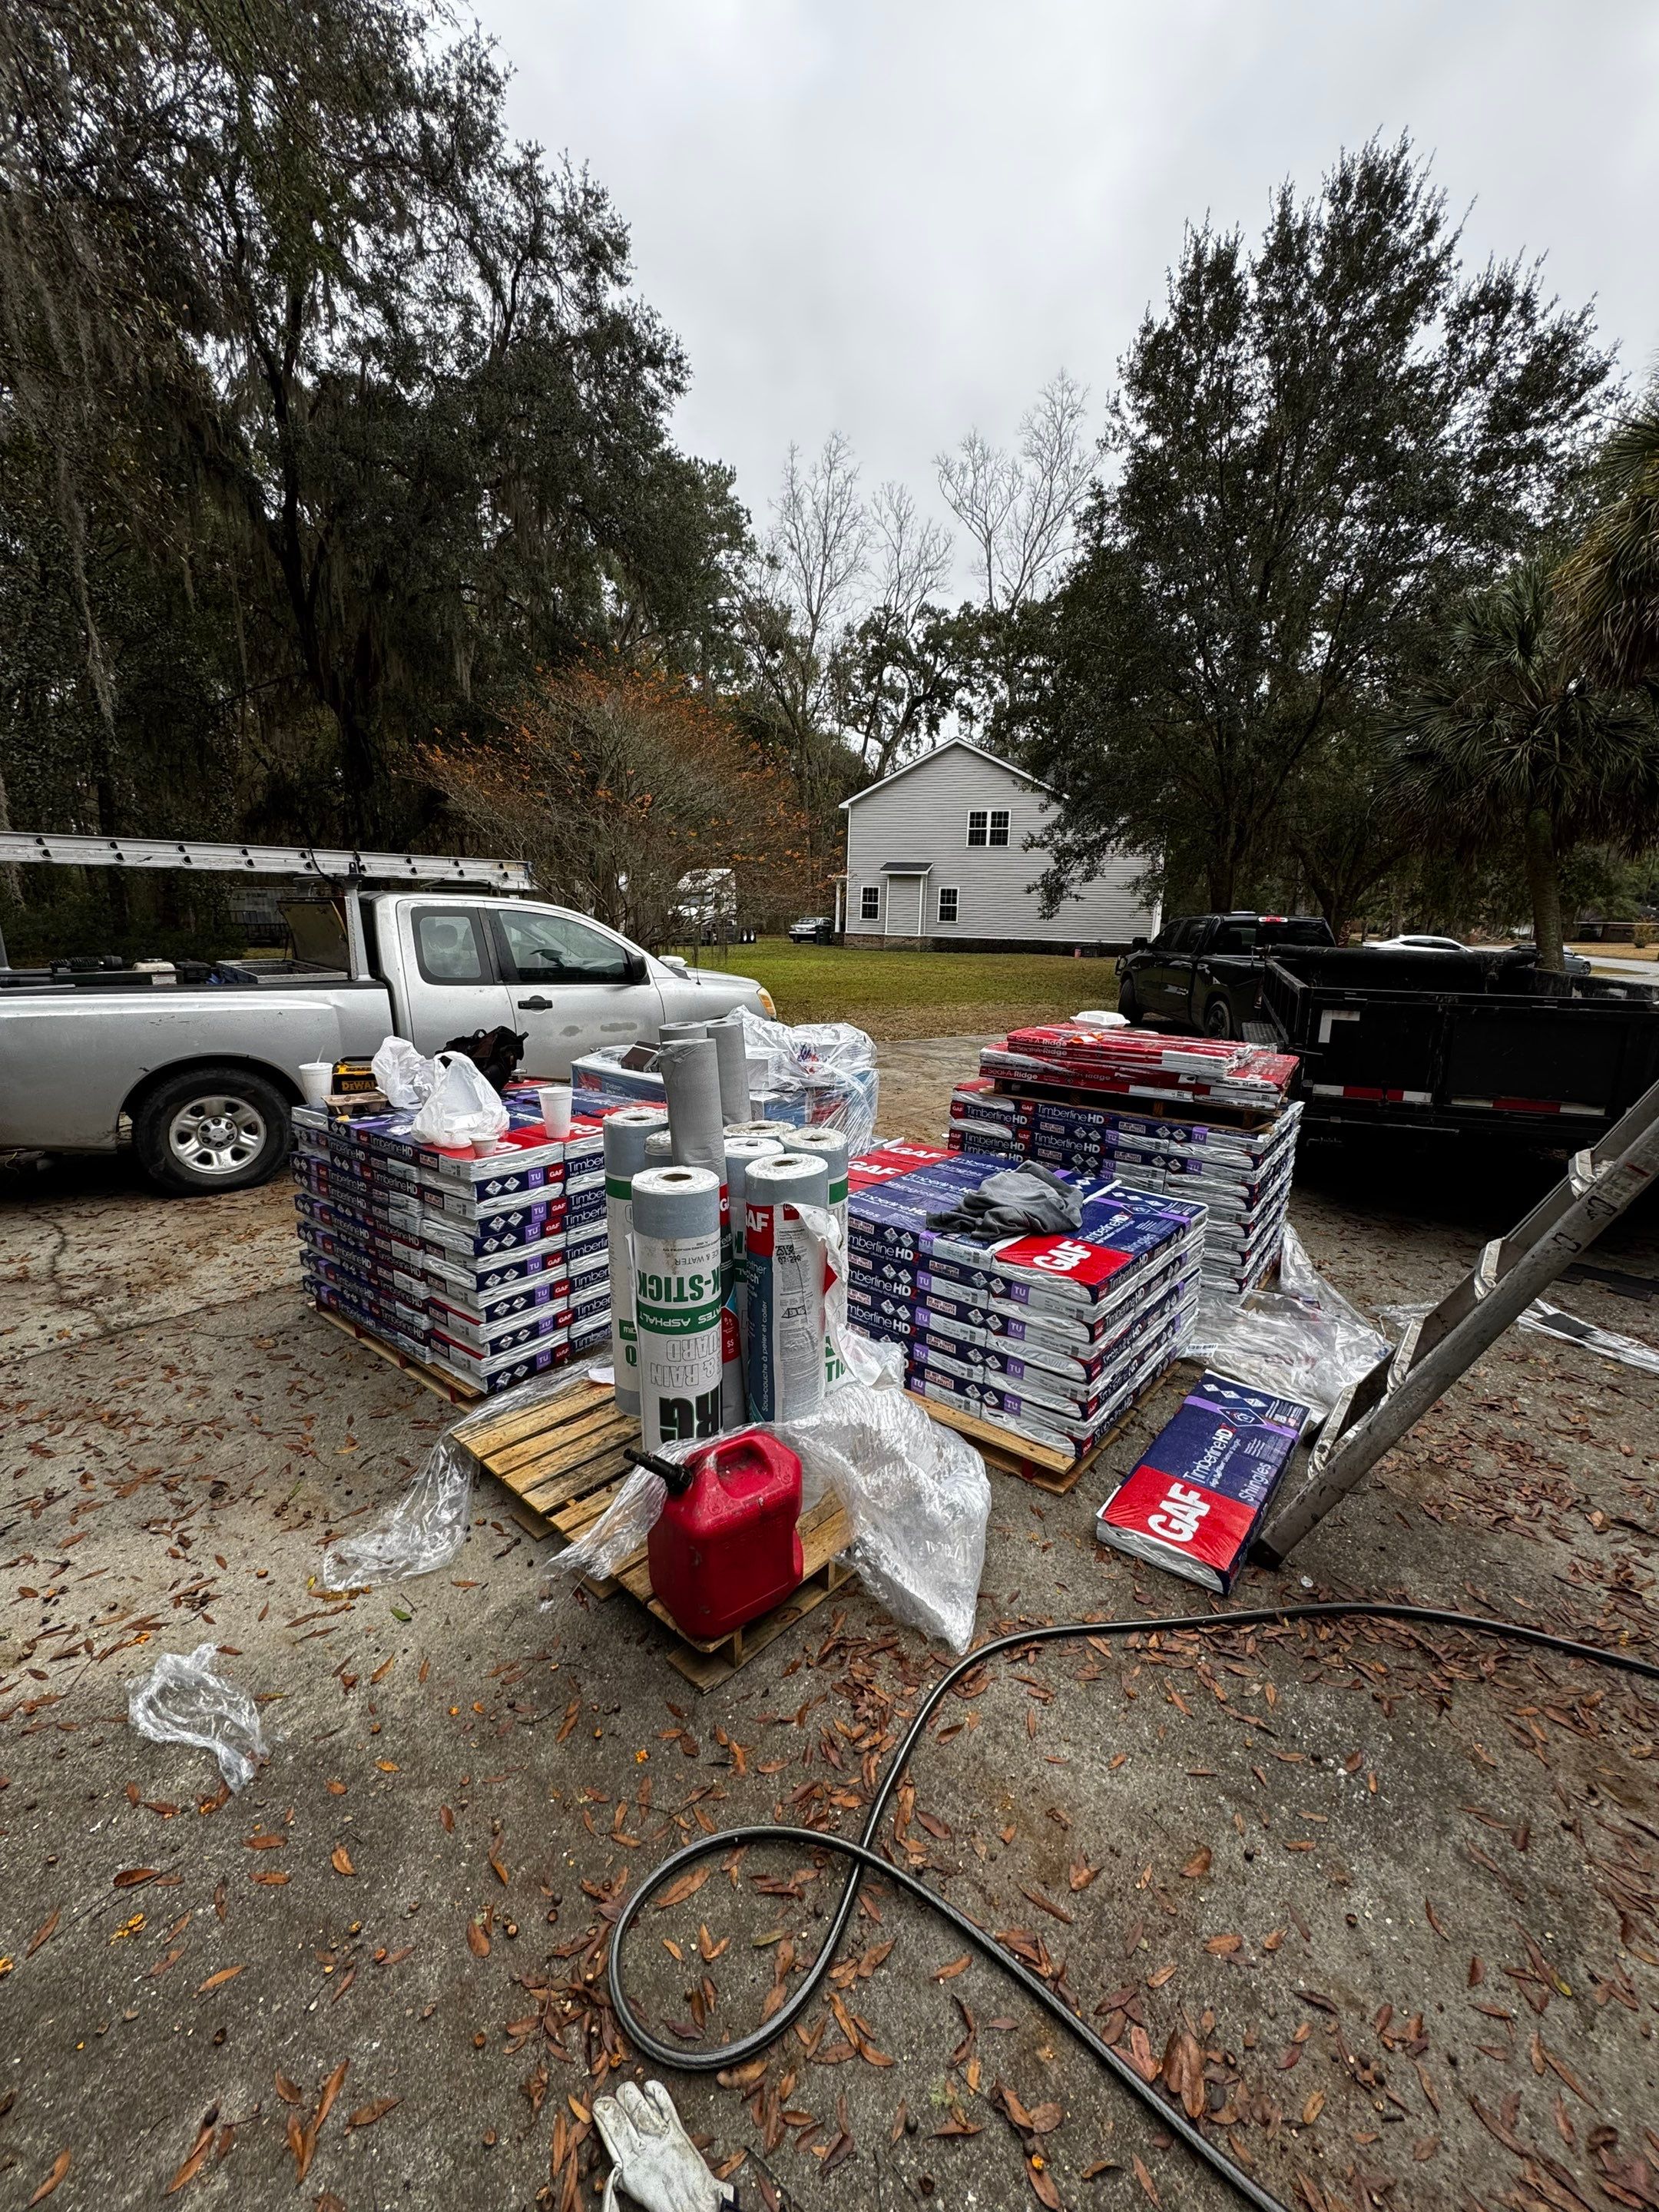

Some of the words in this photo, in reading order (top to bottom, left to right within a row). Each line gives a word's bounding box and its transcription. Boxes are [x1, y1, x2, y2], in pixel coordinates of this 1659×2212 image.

[987, 1068, 1038, 1080] Seal-A-Ridge
[889, 1147, 948, 1159] GAF
[530, 1173, 541, 1181] TU
[549, 1169, 563, 1177] GAF
[533, 1207, 544, 1215] TU
[551, 1203, 566, 1211] GAF
[746, 1209, 769, 1233] AF
[527, 1227, 538, 1236] TU
[546, 1222, 560, 1230] GAF
[674, 1255, 704, 1266] WATER
[1033, 1241, 1091, 1271] GAF
[529, 1262, 539, 1270] TU
[548, 1257, 561, 1266] GAF
[919, 1277, 929, 1286] TU
[555, 1284, 569, 1293] GAF
[1015, 1286, 1026, 1296] TU
[558, 1313, 572, 1323] GAF
[639, 1311, 691, 1327] ASPHALT
[918, 1313, 928, 1322] TU
[1011, 1322, 1022, 1332] TU
[667, 1328, 720, 1363] UARD
[703, 1357, 715, 1379] &
[1010, 1363, 1021, 1373] TU
[650, 1362, 700, 1389] RAIN
[913, 1379, 922, 1387] TU
[1007, 1399, 1018, 1409] TU
[1238, 1462, 1272, 1502] Shingles
[1147, 1482, 1210, 1541] GAF
